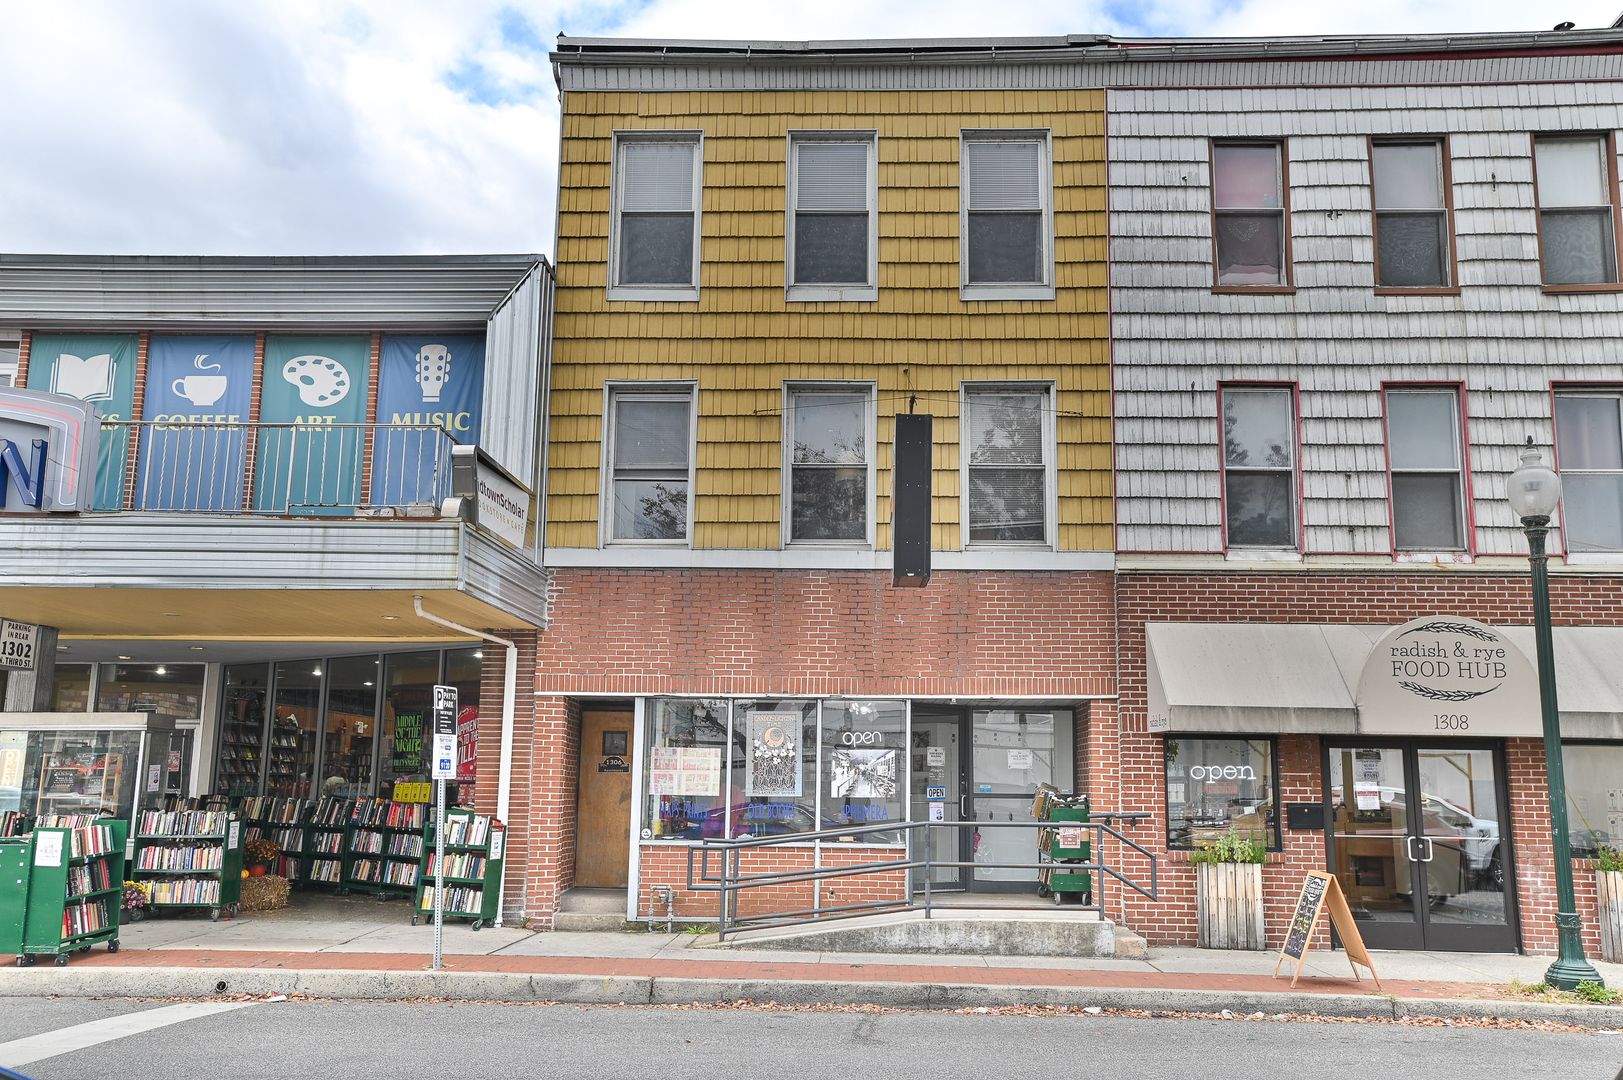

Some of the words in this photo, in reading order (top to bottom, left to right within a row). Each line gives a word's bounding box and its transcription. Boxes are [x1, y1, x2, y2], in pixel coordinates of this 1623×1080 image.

[153, 414, 240, 431] COFFEE
[291, 415, 337, 432] ART
[391, 412, 471, 431] MUSIC
[7, 622, 32, 633] PARKING
[7, 631, 14, 639] IN
[15, 632, 29, 641] REAR
[1, 641, 32, 658] 1302
[1390, 641, 1448, 658] radish
[1453, 641, 1469, 658] &
[1473, 648, 1505, 661] rye
[6, 657, 23, 666] THIRD
[24, 660, 32, 668] ST.
[1391, 660, 1450, 678] FOOD
[1457, 661, 1507, 679] HUB
[443, 692, 451, 700] PAY
[443, 700, 454, 709] PARK
[396, 715, 421, 727] MIDDLE
[1433, 714, 1469, 730] 1308
[842, 731, 882, 747] open
[1190, 765, 1256, 784] open
[928, 788, 944, 798] OPEN
[660, 801, 680, 818] MAPS
[768, 803, 795, 818] BOOKS
[841, 804, 888, 820] EPHEMERA
